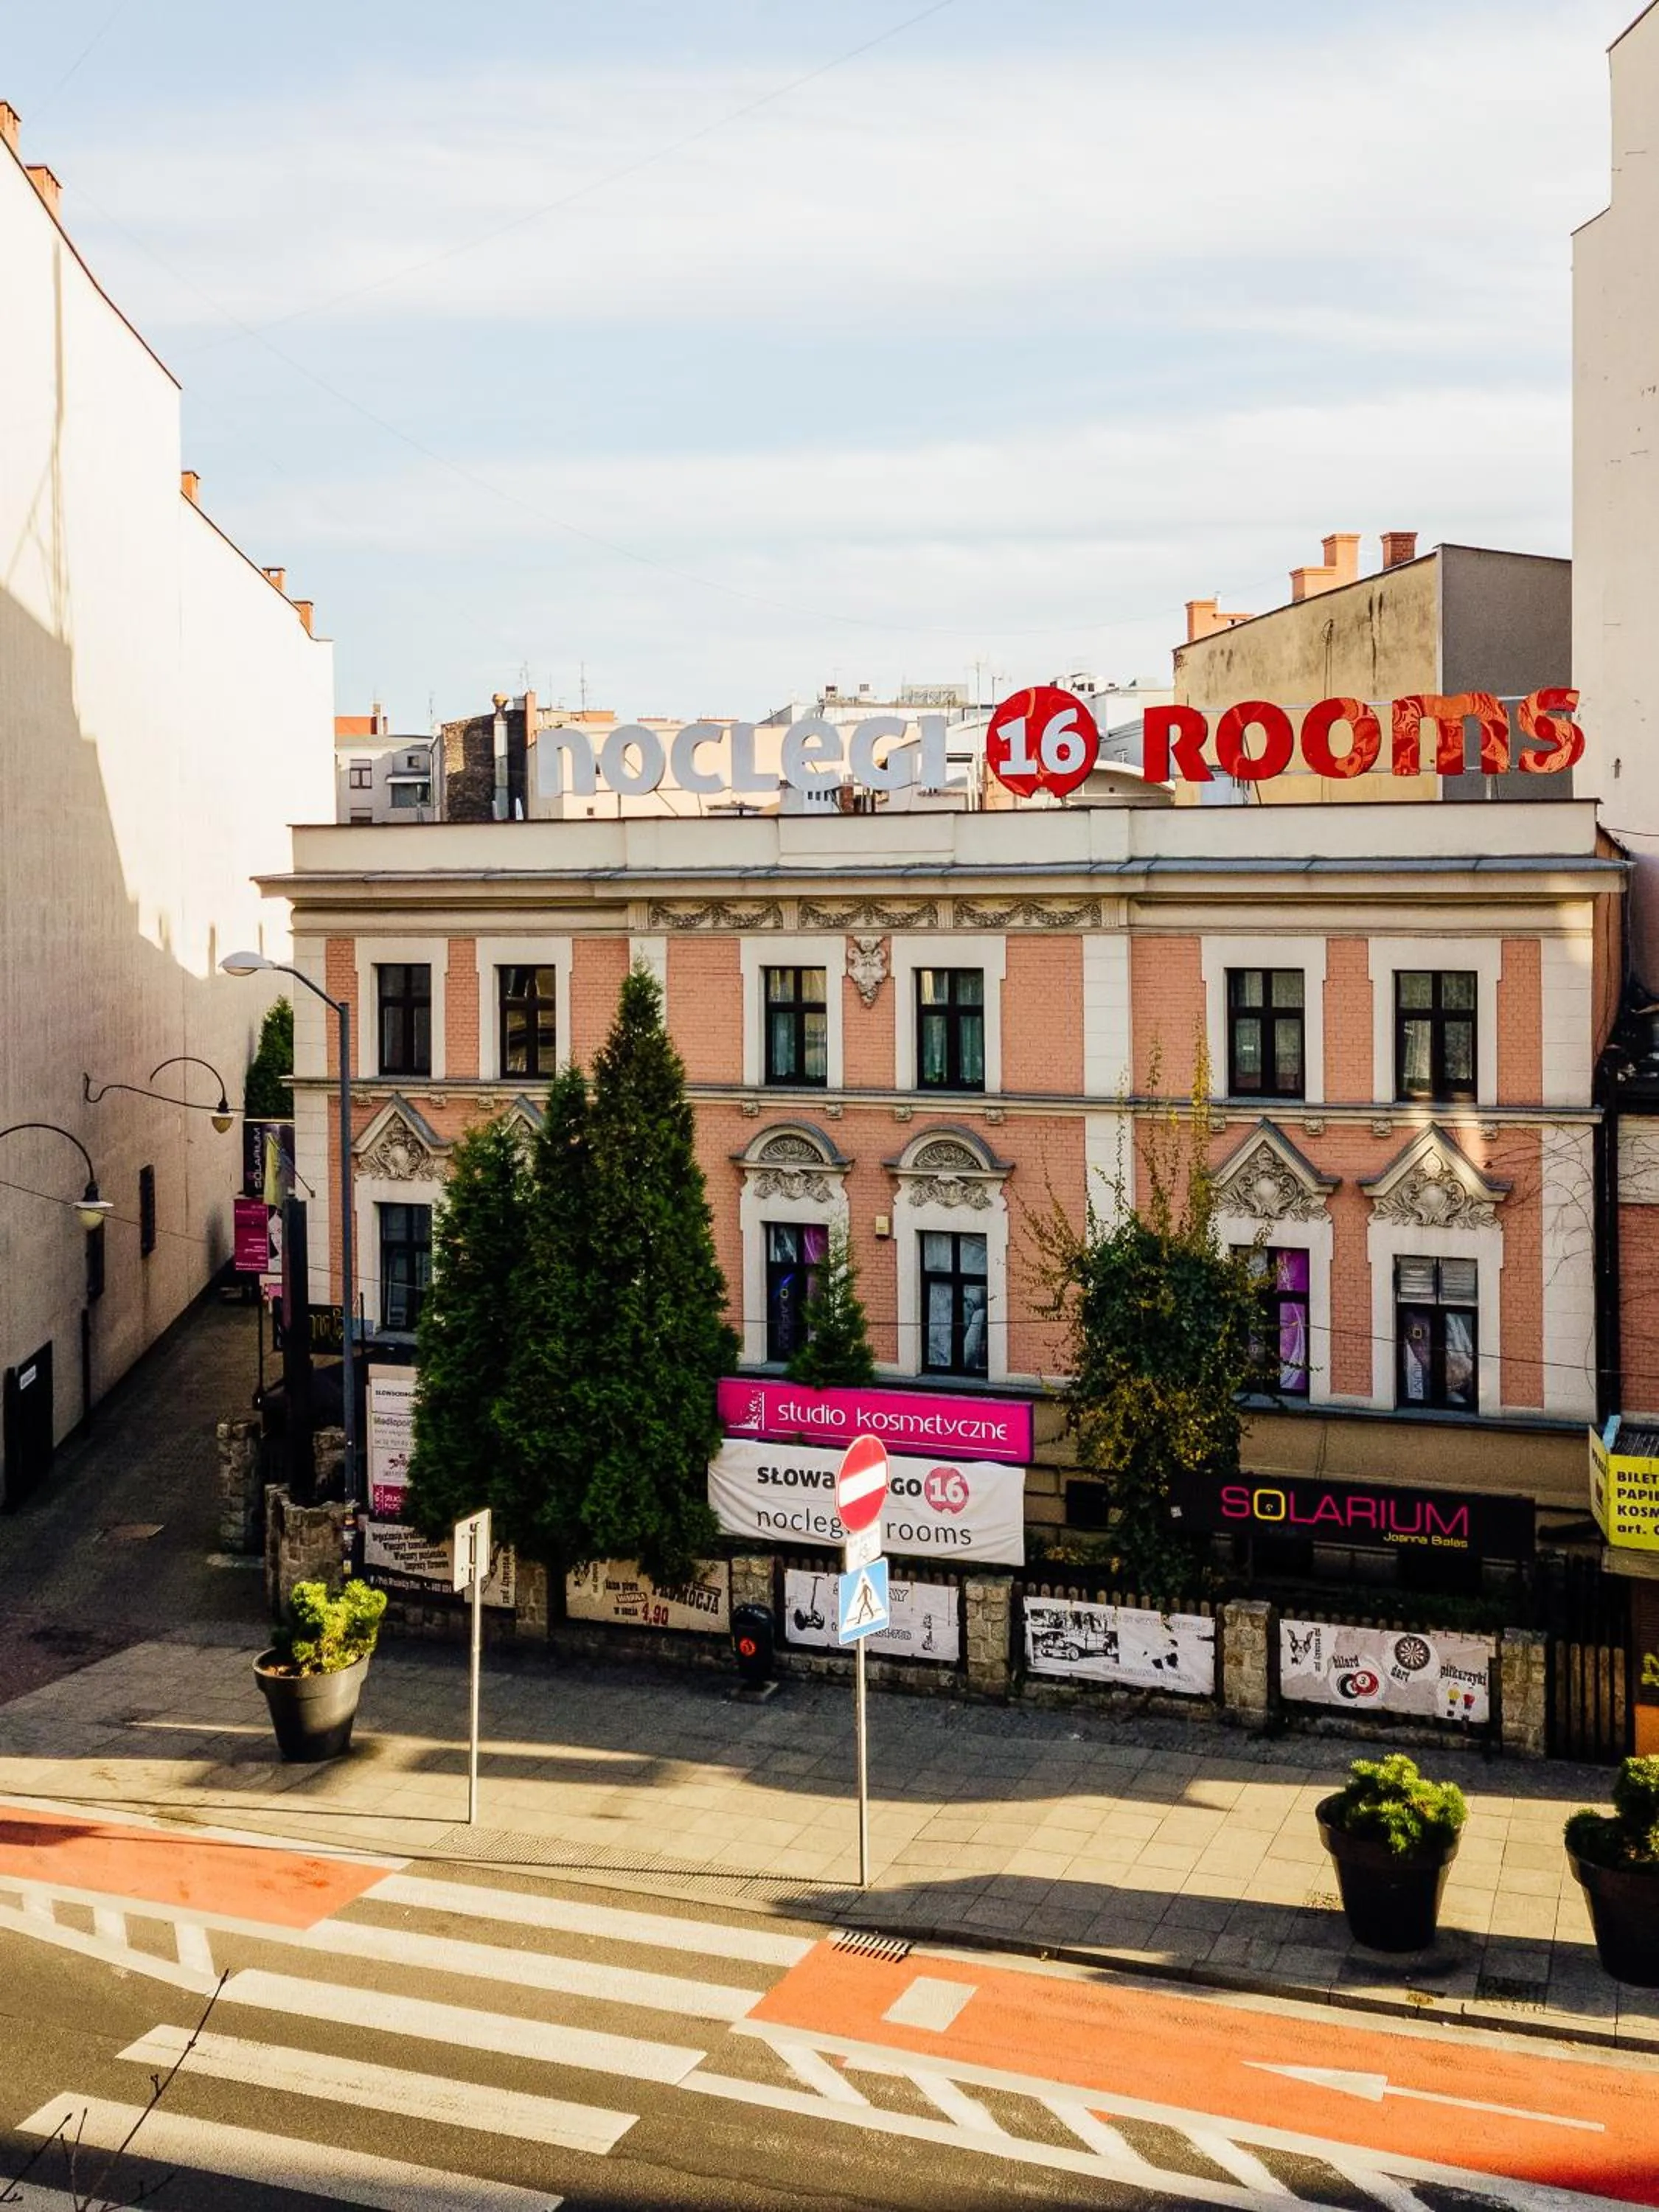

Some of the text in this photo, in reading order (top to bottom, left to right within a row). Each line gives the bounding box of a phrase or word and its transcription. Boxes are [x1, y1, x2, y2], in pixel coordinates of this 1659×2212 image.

[995, 708, 1088, 776] 16
[777, 1399, 1008, 1441] studio kosmetyczne
[757, 1466, 966, 1505] SŁOWAGO 16
[757, 1507, 851, 1540] nocleg
[886, 1520, 972, 1545] rooms
[1221, 1486, 1469, 1537] SOLARIUM
[1382, 1531, 1428, 1545] Joanna
